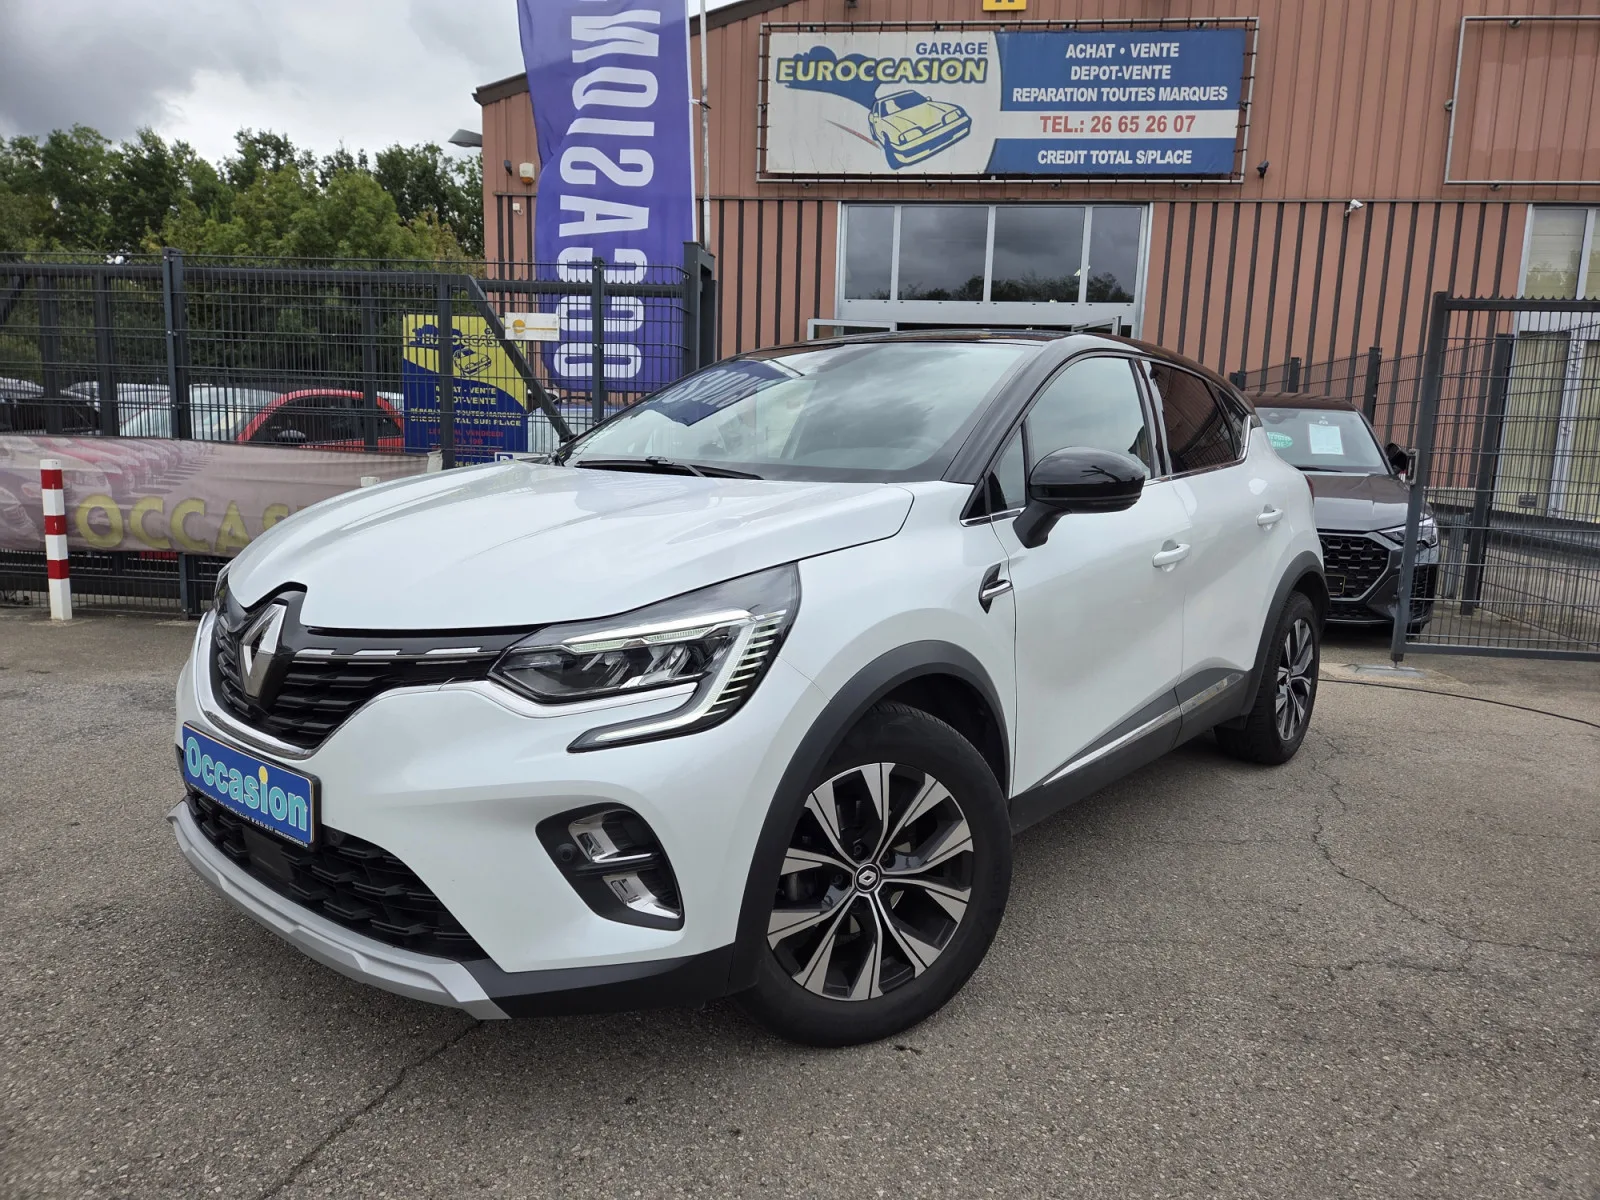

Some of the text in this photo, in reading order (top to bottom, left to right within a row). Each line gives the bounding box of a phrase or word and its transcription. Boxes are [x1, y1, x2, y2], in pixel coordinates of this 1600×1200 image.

[915, 42, 988, 56] GARAGE
[1065, 42, 1180, 59] ACHAT VENTE
[776, 57, 989, 84] EUROCCASION
[1070, 65, 1171, 80] DEPOT-VENTE
[1012, 86, 1228, 102] REPARATION TOUTES MARQUES
[1039, 115, 1196, 133] TEL.: 26 65 26 07
[1037, 150, 1192, 165] CREDIT TOTAL S/PLACE
[420, 334, 524, 348] EUOCCAS
[470, 387, 497, 395] VENTE
[75, 494, 306, 552] OCCA
[186, 736, 308, 832] Occasion
